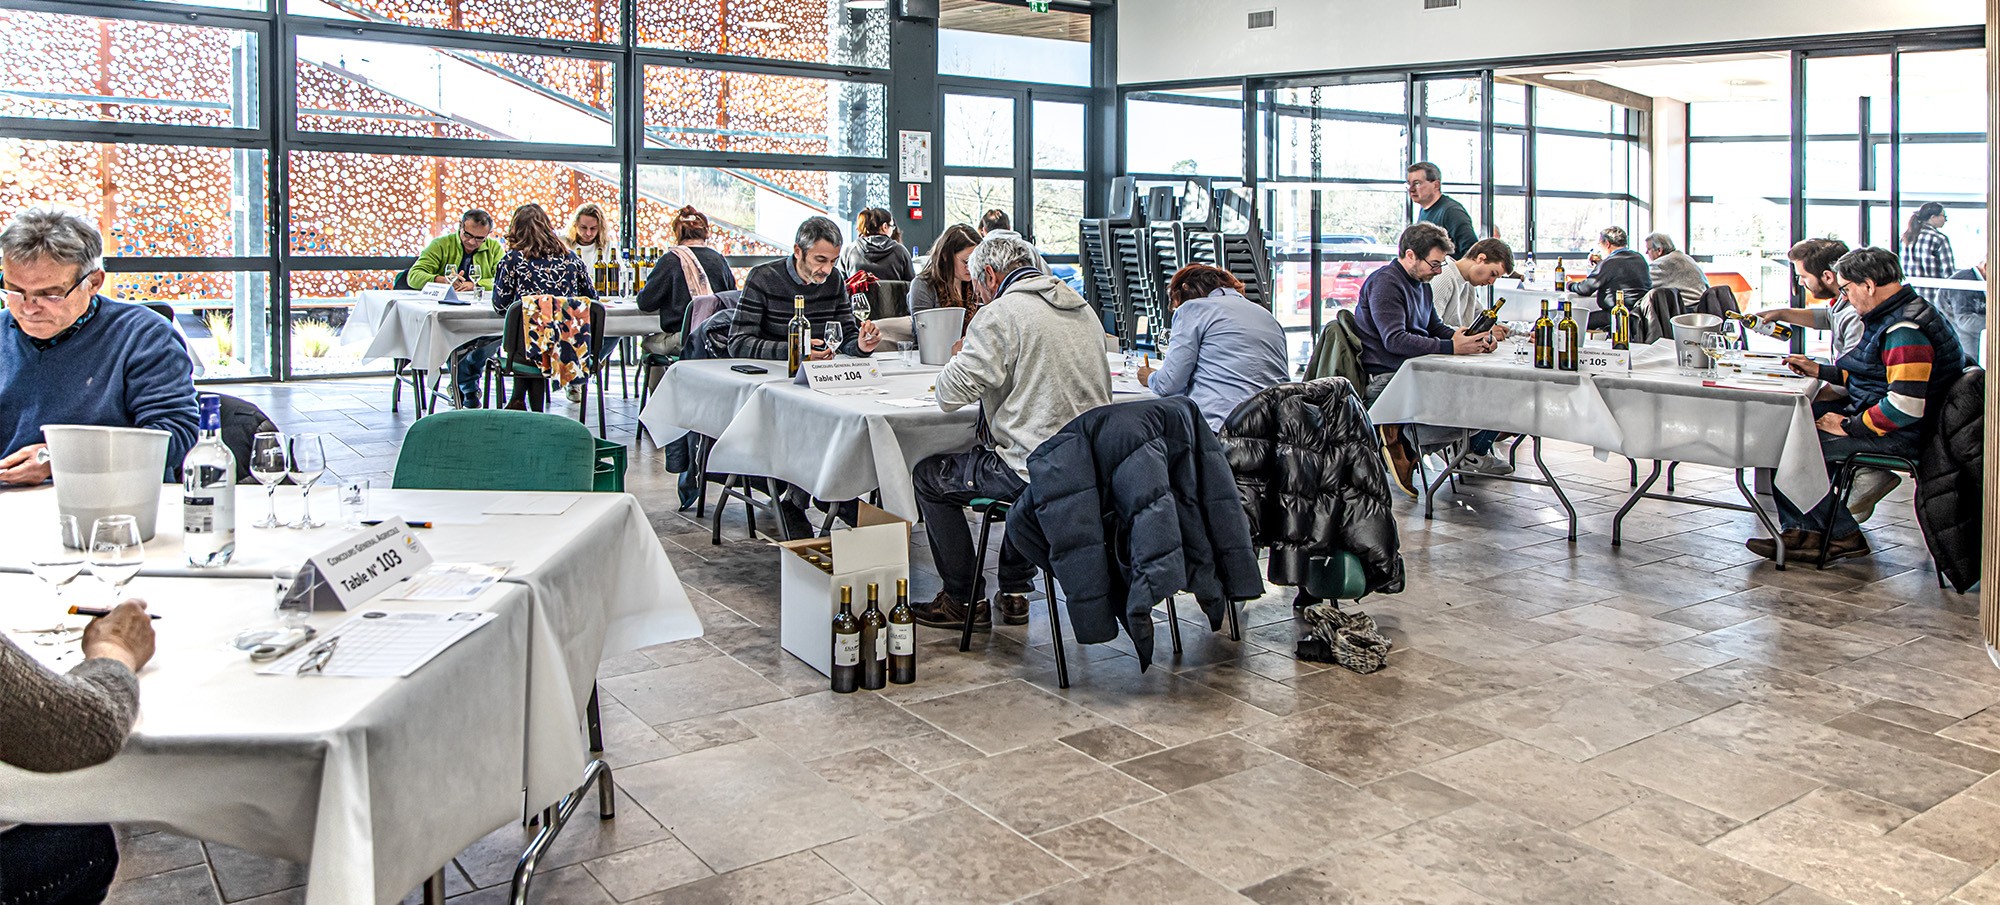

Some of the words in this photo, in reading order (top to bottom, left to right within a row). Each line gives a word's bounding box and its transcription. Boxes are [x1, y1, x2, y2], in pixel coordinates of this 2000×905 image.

[1589, 358, 1607, 367] 105
[844, 371, 862, 380] 104
[340, 572, 370, 592] Table
[366, 563, 378, 579] N°
[376, 548, 403, 572] 103
